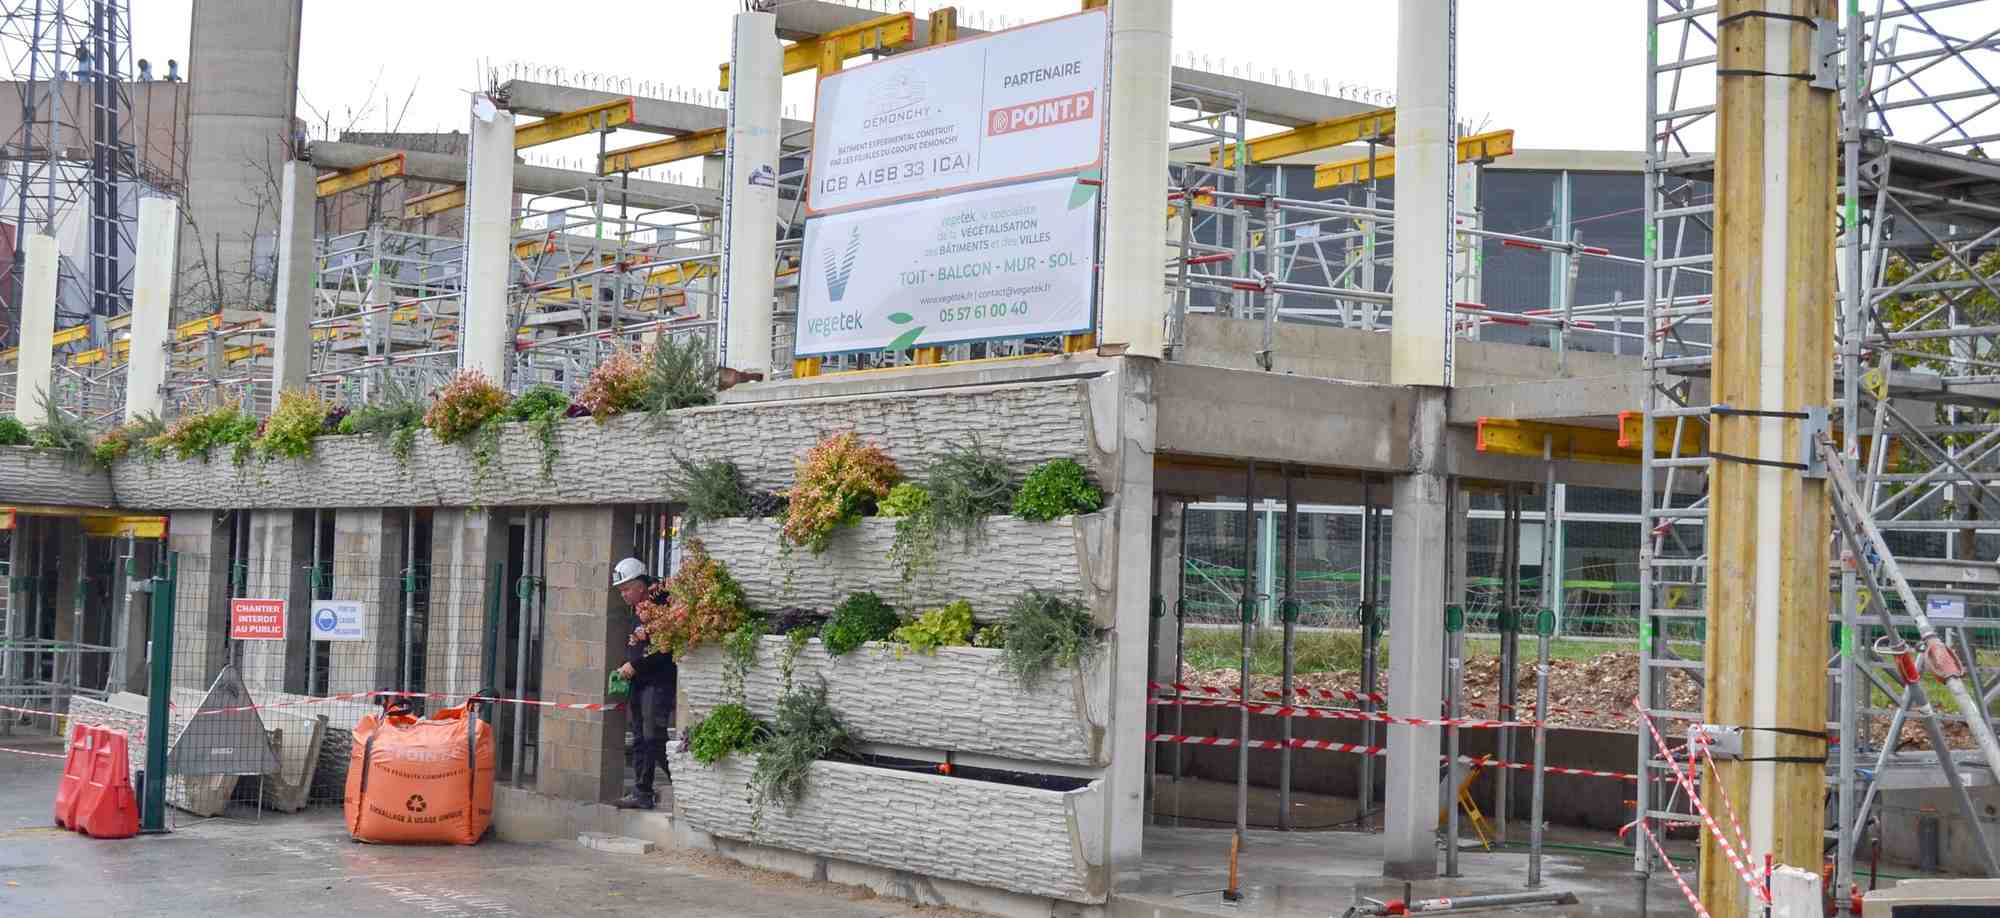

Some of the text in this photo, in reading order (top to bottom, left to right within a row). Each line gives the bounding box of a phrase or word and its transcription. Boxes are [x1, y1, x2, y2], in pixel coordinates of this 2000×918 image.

[1003, 61, 1081, 89] PARTENAIRE
[1011, 96, 1089, 130] POINT.P
[915, 125, 955, 139] CONSTRUIT
[891, 142, 919, 155] GROUPE
[856, 166, 898, 187] AISB
[904, 160, 925, 178] 33
[961, 218, 1038, 240] VÉGÉTALISATION
[939, 240, 990, 256] BÂTIMENTS
[1019, 232, 1051, 248] VILLES
[900, 269, 927, 286] TOIT
[938, 262, 992, 281] BALCON
[1004, 255, 1036, 274] MUR
[1049, 251, 1077, 269] SOL
[939, 301, 1028, 322] 05 57 61 00 40
[807, 309, 863, 337] vegetek
[236, 604, 281, 613] CHANTIER
[238, 615, 277, 623] INTERDIT
[235, 624, 281, 633] AU PUBLIC
[414, 815, 437, 824] USAGE
